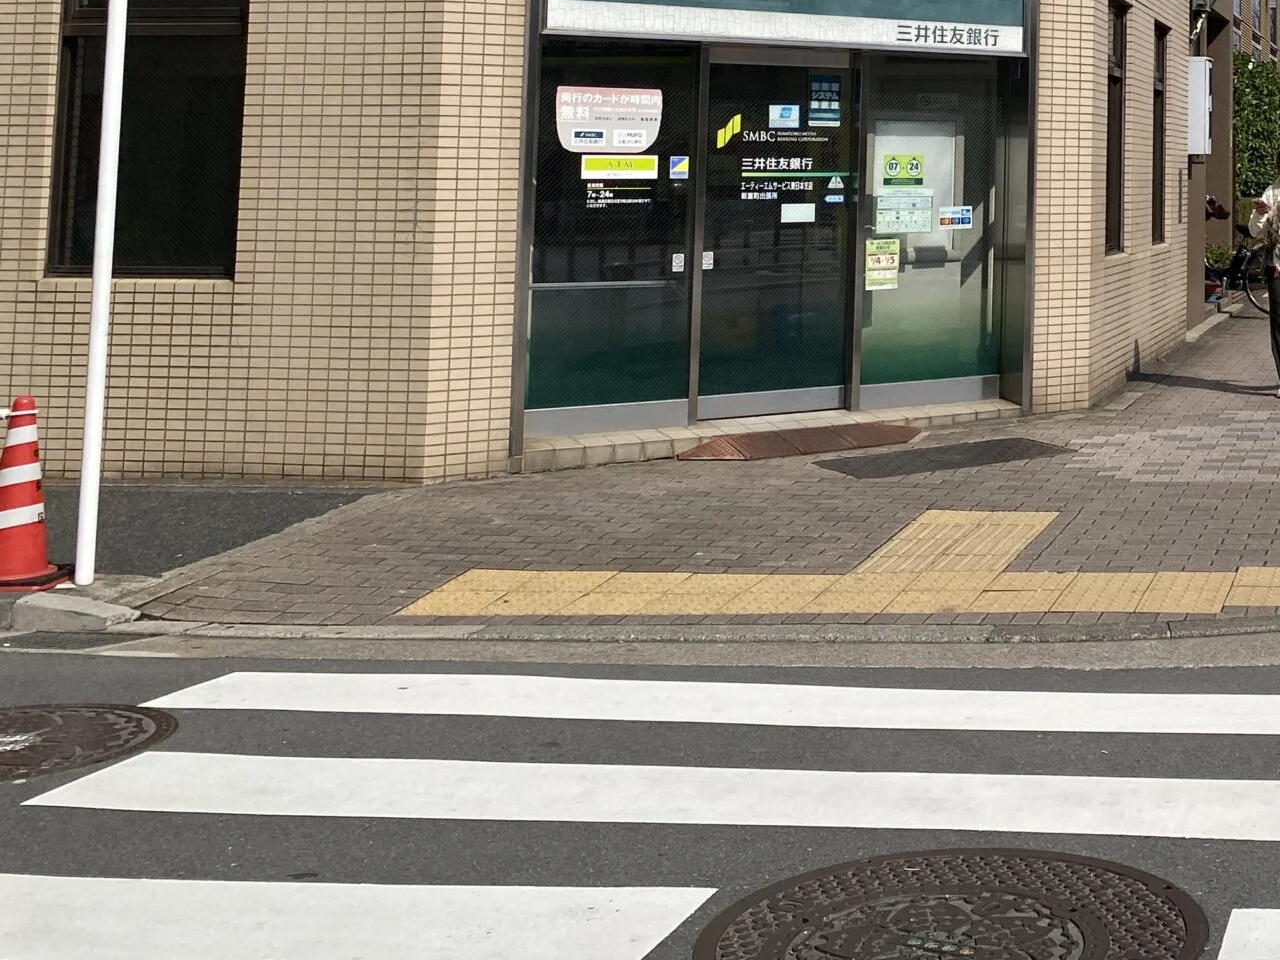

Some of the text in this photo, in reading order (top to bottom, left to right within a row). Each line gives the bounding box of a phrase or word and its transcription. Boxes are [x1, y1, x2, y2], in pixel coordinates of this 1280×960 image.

[896, 24, 1000, 47] 三井住友銀行
[560, 105, 590, 120] 無料
[742, 130, 776, 143] SMBC
[741, 157, 814, 170] 三井住友銀行
[888, 162, 898, 171] 07
[909, 162, 919, 171] 24
